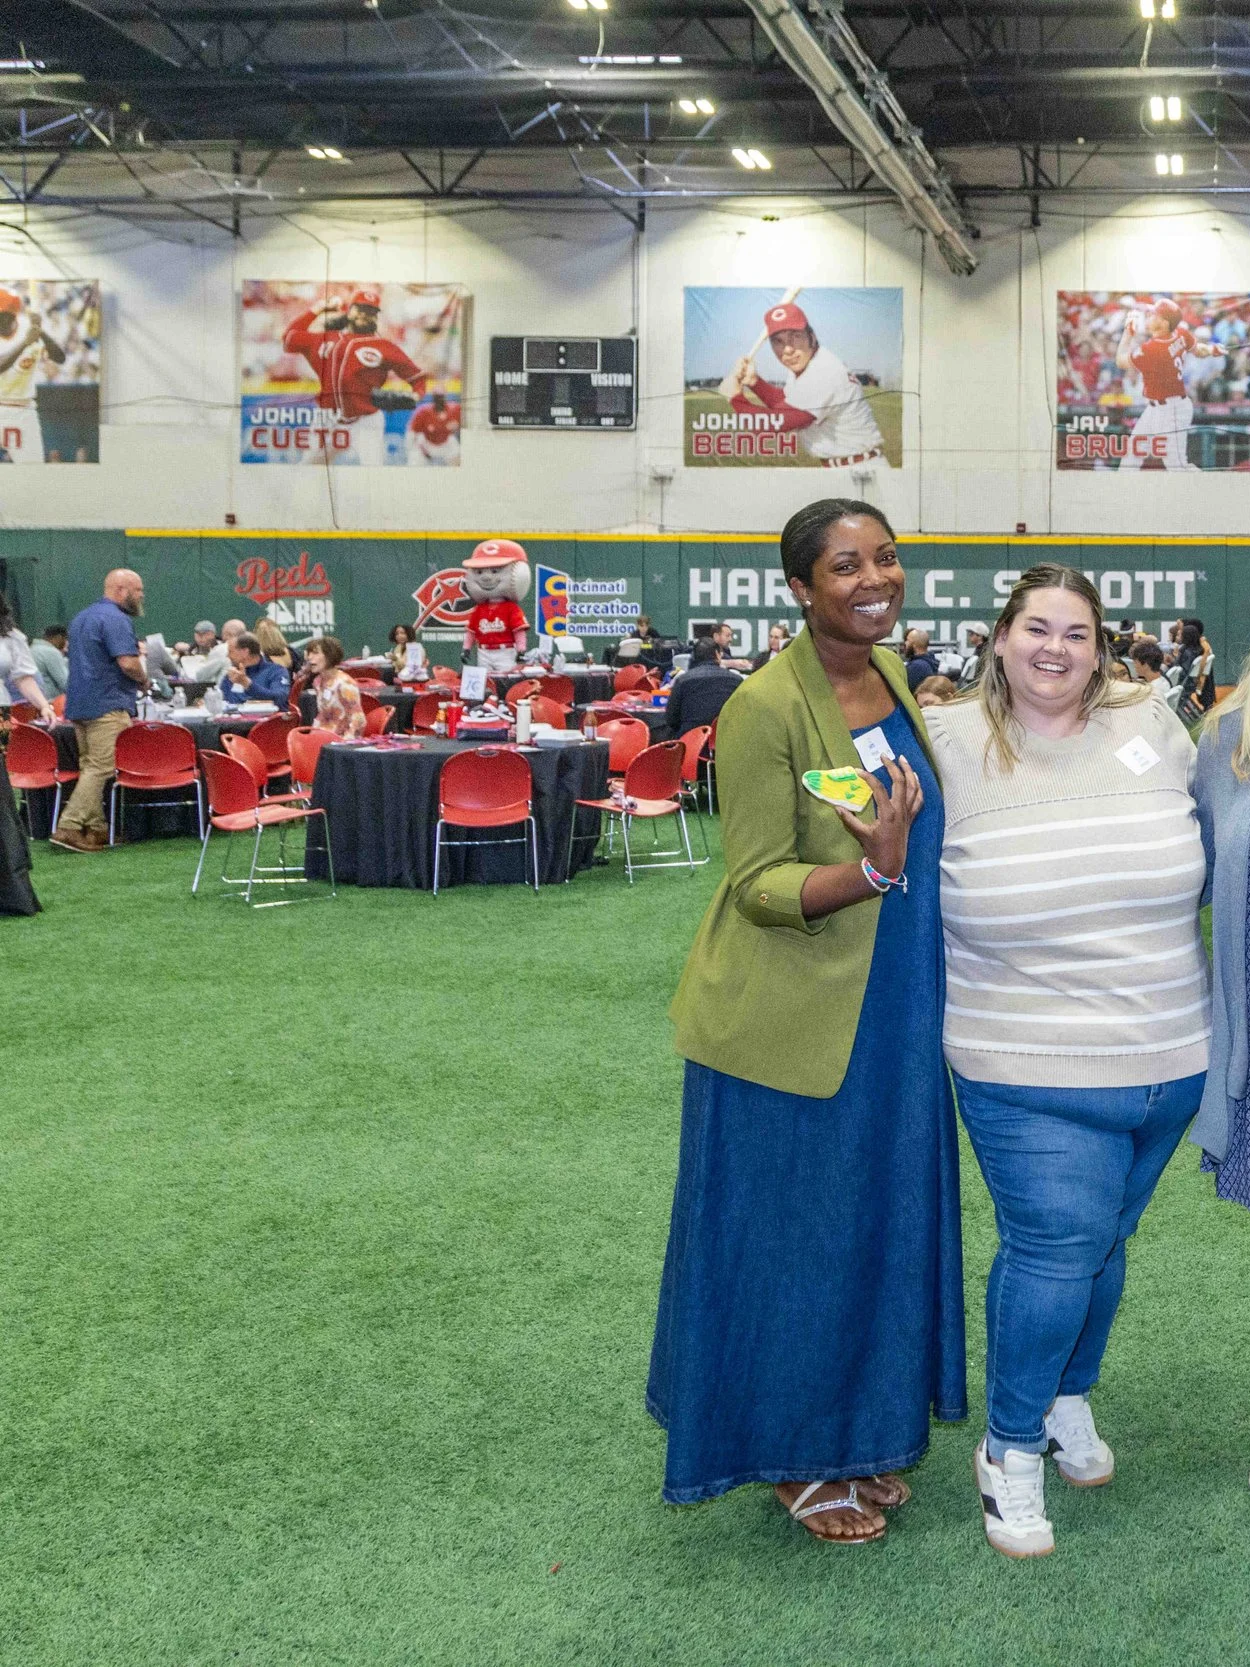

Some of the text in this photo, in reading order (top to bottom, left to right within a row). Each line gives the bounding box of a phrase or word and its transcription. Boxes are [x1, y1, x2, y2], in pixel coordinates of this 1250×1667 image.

[591, 373, 632, 387] VISITOR
[692, 413, 785, 430] JOHNNY
[1065, 415, 1109, 432] JAY
[251, 428, 350, 449] CUETO
[693, 432, 798, 456] BENCH
[1065, 434, 1169, 458] BRUCE
[235, 551, 331, 605] Reds
[545, 575, 626, 597] Cincinnati
[689, 568, 1195, 609] HAR C. SOTT
[295, 600, 334, 625] RBI
[540, 595, 639, 620] Recreation
